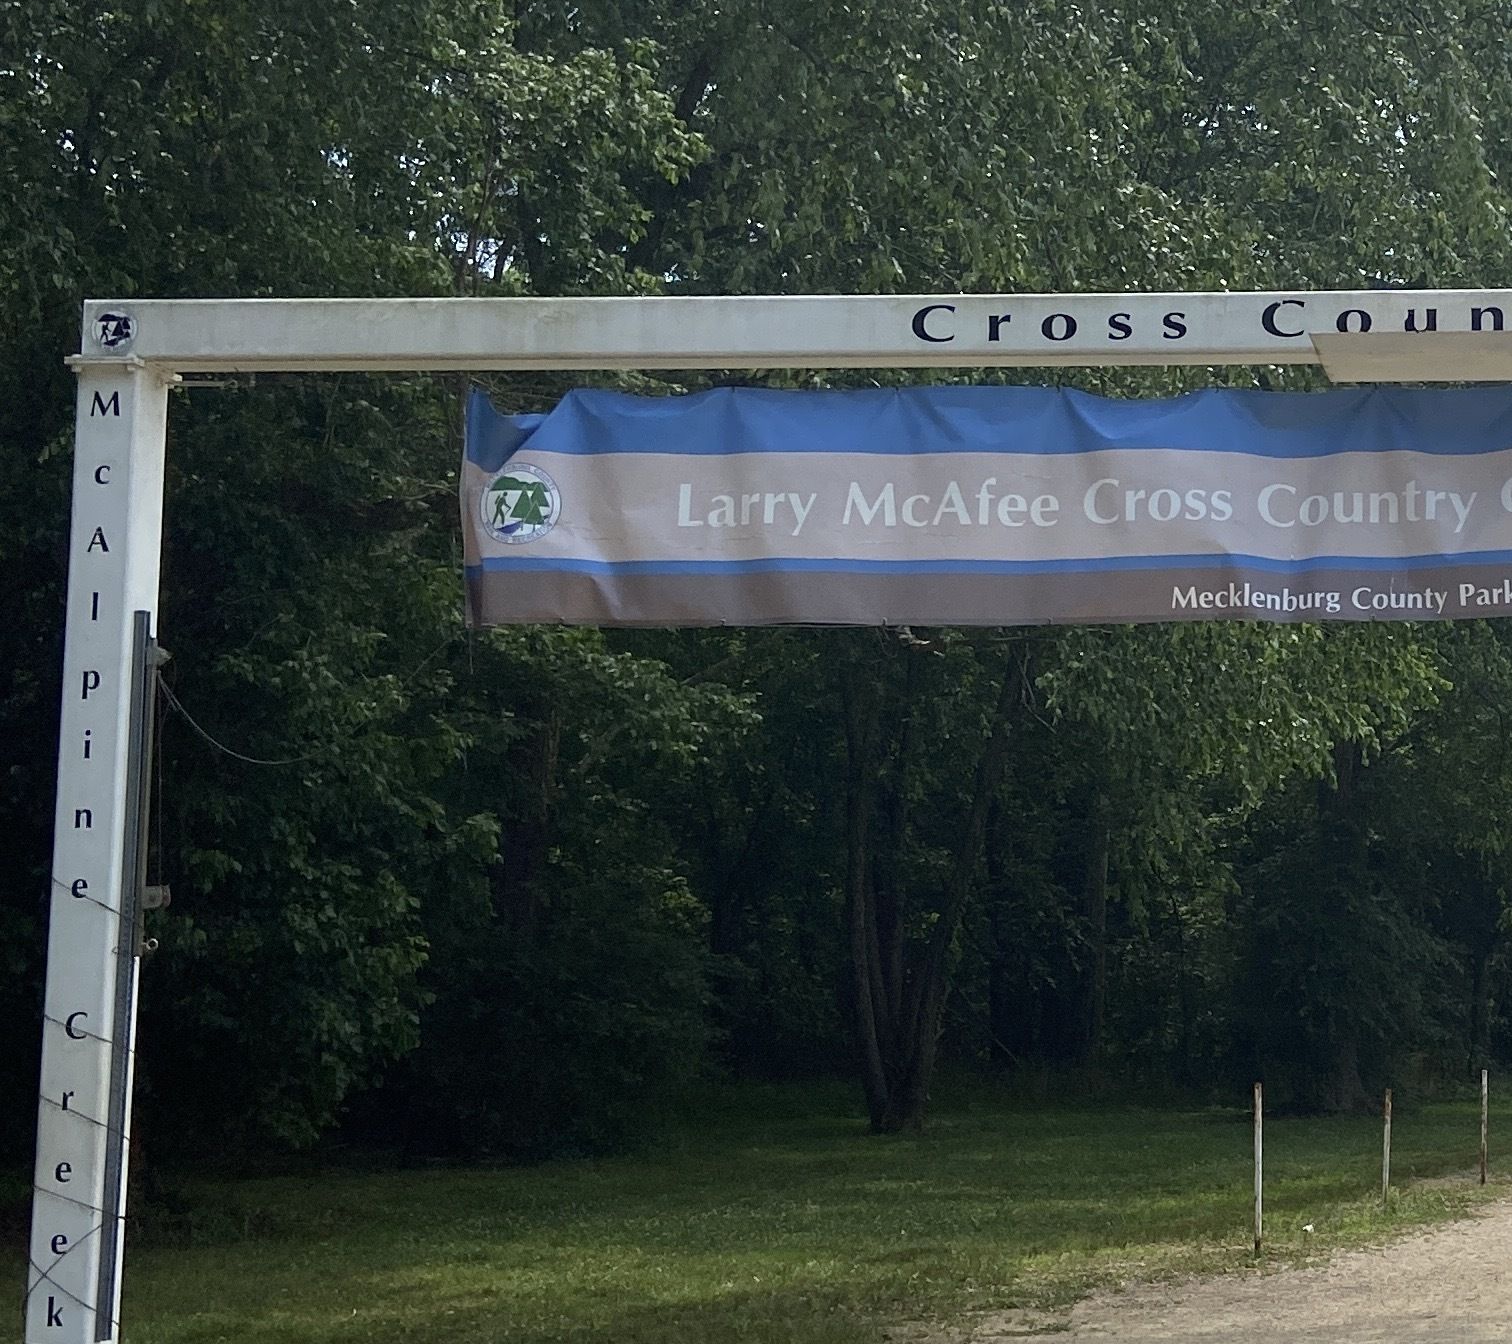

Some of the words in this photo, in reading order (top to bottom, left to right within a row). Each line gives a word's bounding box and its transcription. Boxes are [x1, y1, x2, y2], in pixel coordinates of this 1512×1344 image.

[910, 303, 1188, 343] Cross
[676, 483, 817, 536] Larry
[842, 476, 1060, 528] McAfee
[1083, 478, 1233, 525] Cross
[1257, 479, 1477, 533] Country
[1170, 583, 1341, 613] Mecklenburg
[1351, 586, 1448, 615] County
[70, 390, 121, 899] McAlpine
[45, 1010, 89, 1329] Creek
